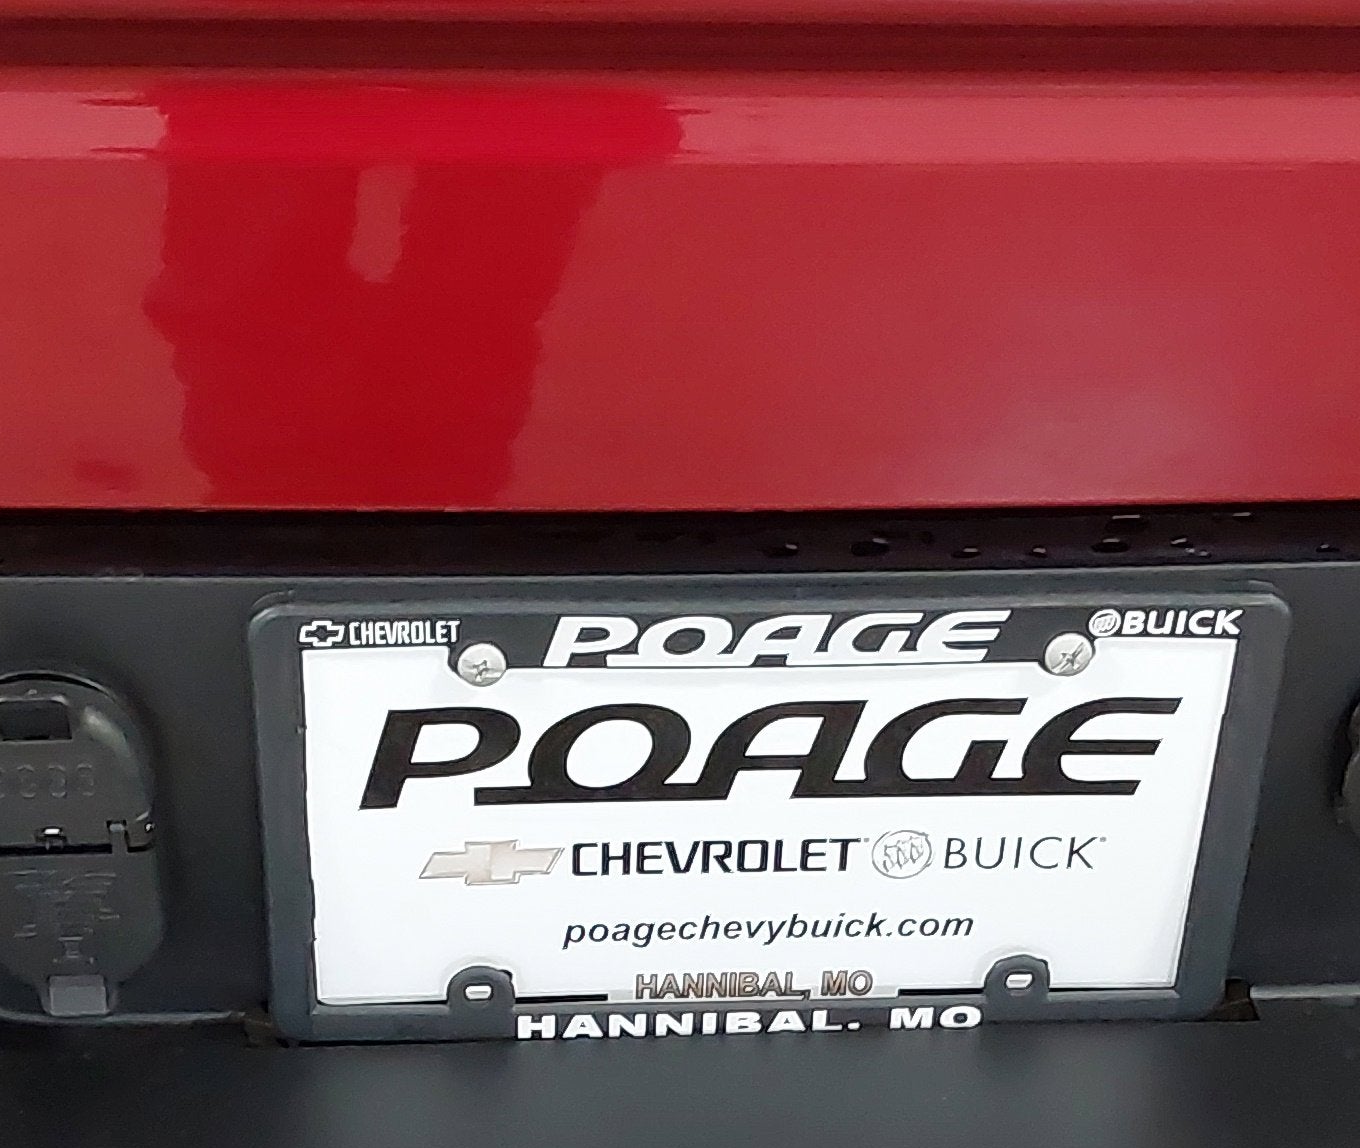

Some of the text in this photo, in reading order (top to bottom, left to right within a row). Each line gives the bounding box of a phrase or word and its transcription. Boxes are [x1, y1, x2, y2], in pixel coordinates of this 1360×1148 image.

[349, 620, 461, 646] CHEVROLET
[1121, 609, 1244, 635] BUICK
[543, 611, 1011, 667] POAGE
[359, 698, 1181, 810] POAGE
[572, 836, 1099, 876] CHEVROLET BUICK
[562, 912, 975, 950] poagechevybuick.com
[821, 970, 874, 996] MO
[889, 1005, 983, 1032] MO
